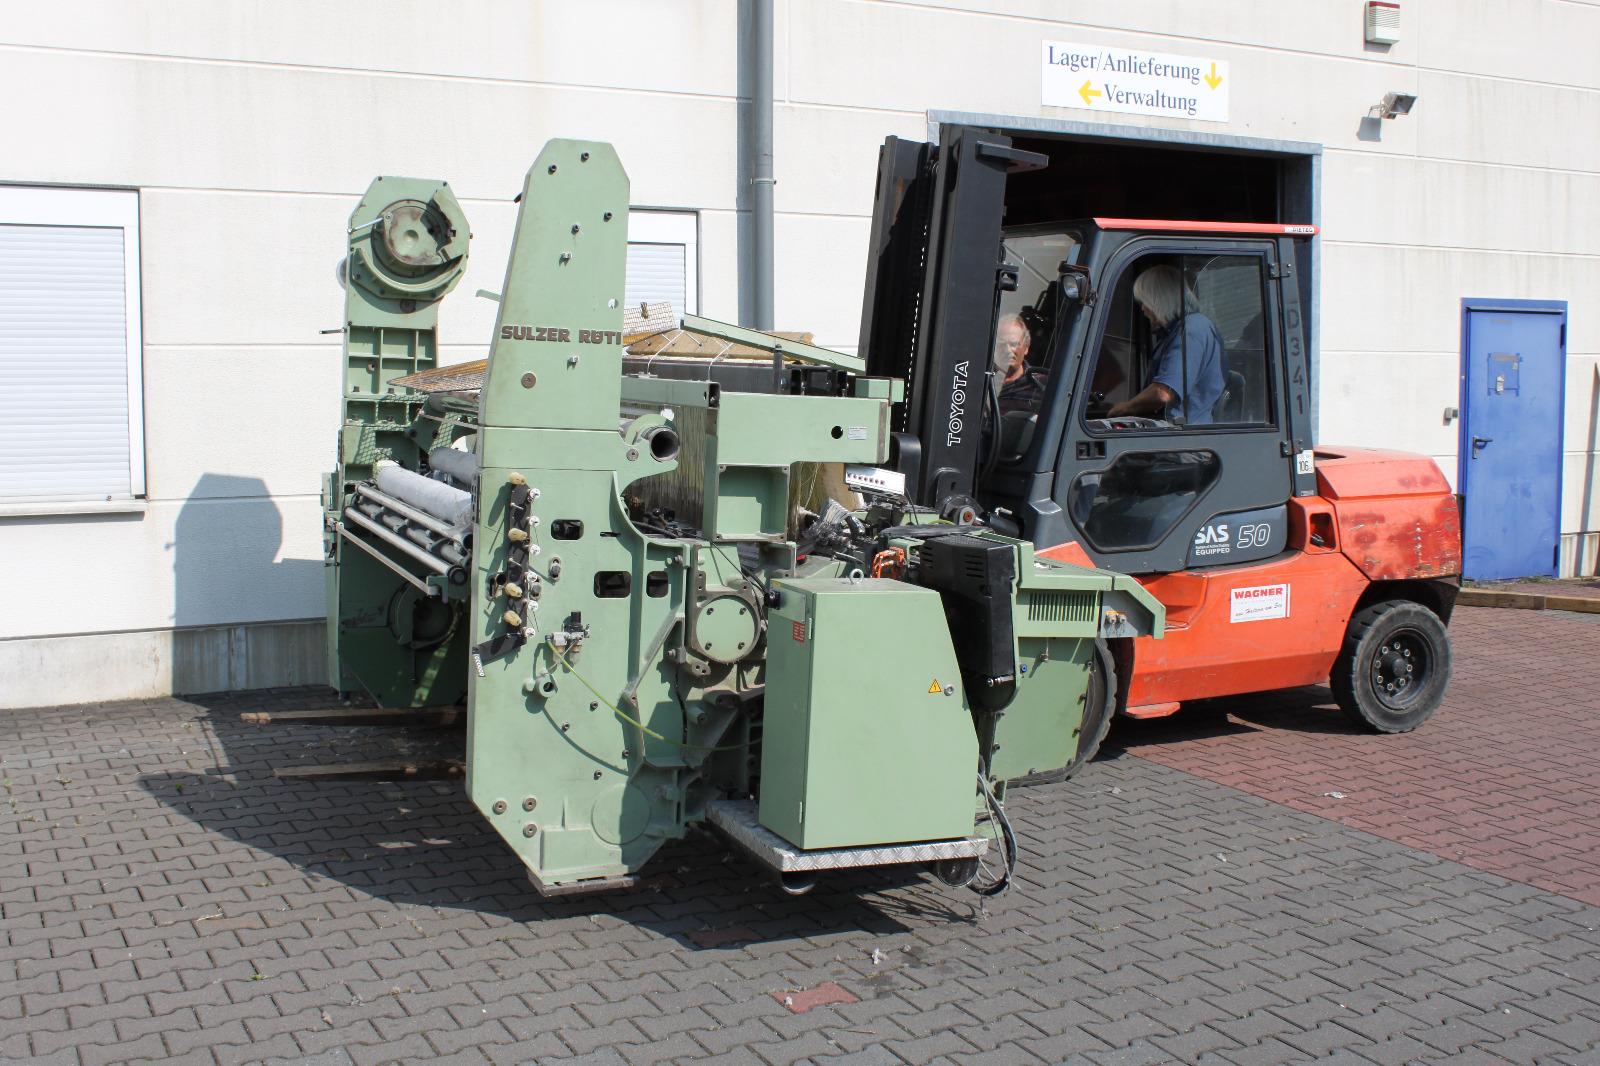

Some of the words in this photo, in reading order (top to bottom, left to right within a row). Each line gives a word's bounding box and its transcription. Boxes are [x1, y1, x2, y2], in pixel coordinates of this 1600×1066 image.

[1048, 45, 1200, 86] Lager/Anlieferung
[1104, 83, 1198, 116] Verwaltung
[501, 325, 571, 343] SULZER
[578, 329, 622, 346] RÜTI
[947, 360, 969, 447] TOYOTA
[1194, 524, 1230, 545] SAS
[1237, 523, 1271, 549] 50
[1195, 547, 1231, 556] EQUIPPED
[1234, 587, 1283, 600] WAGNER
